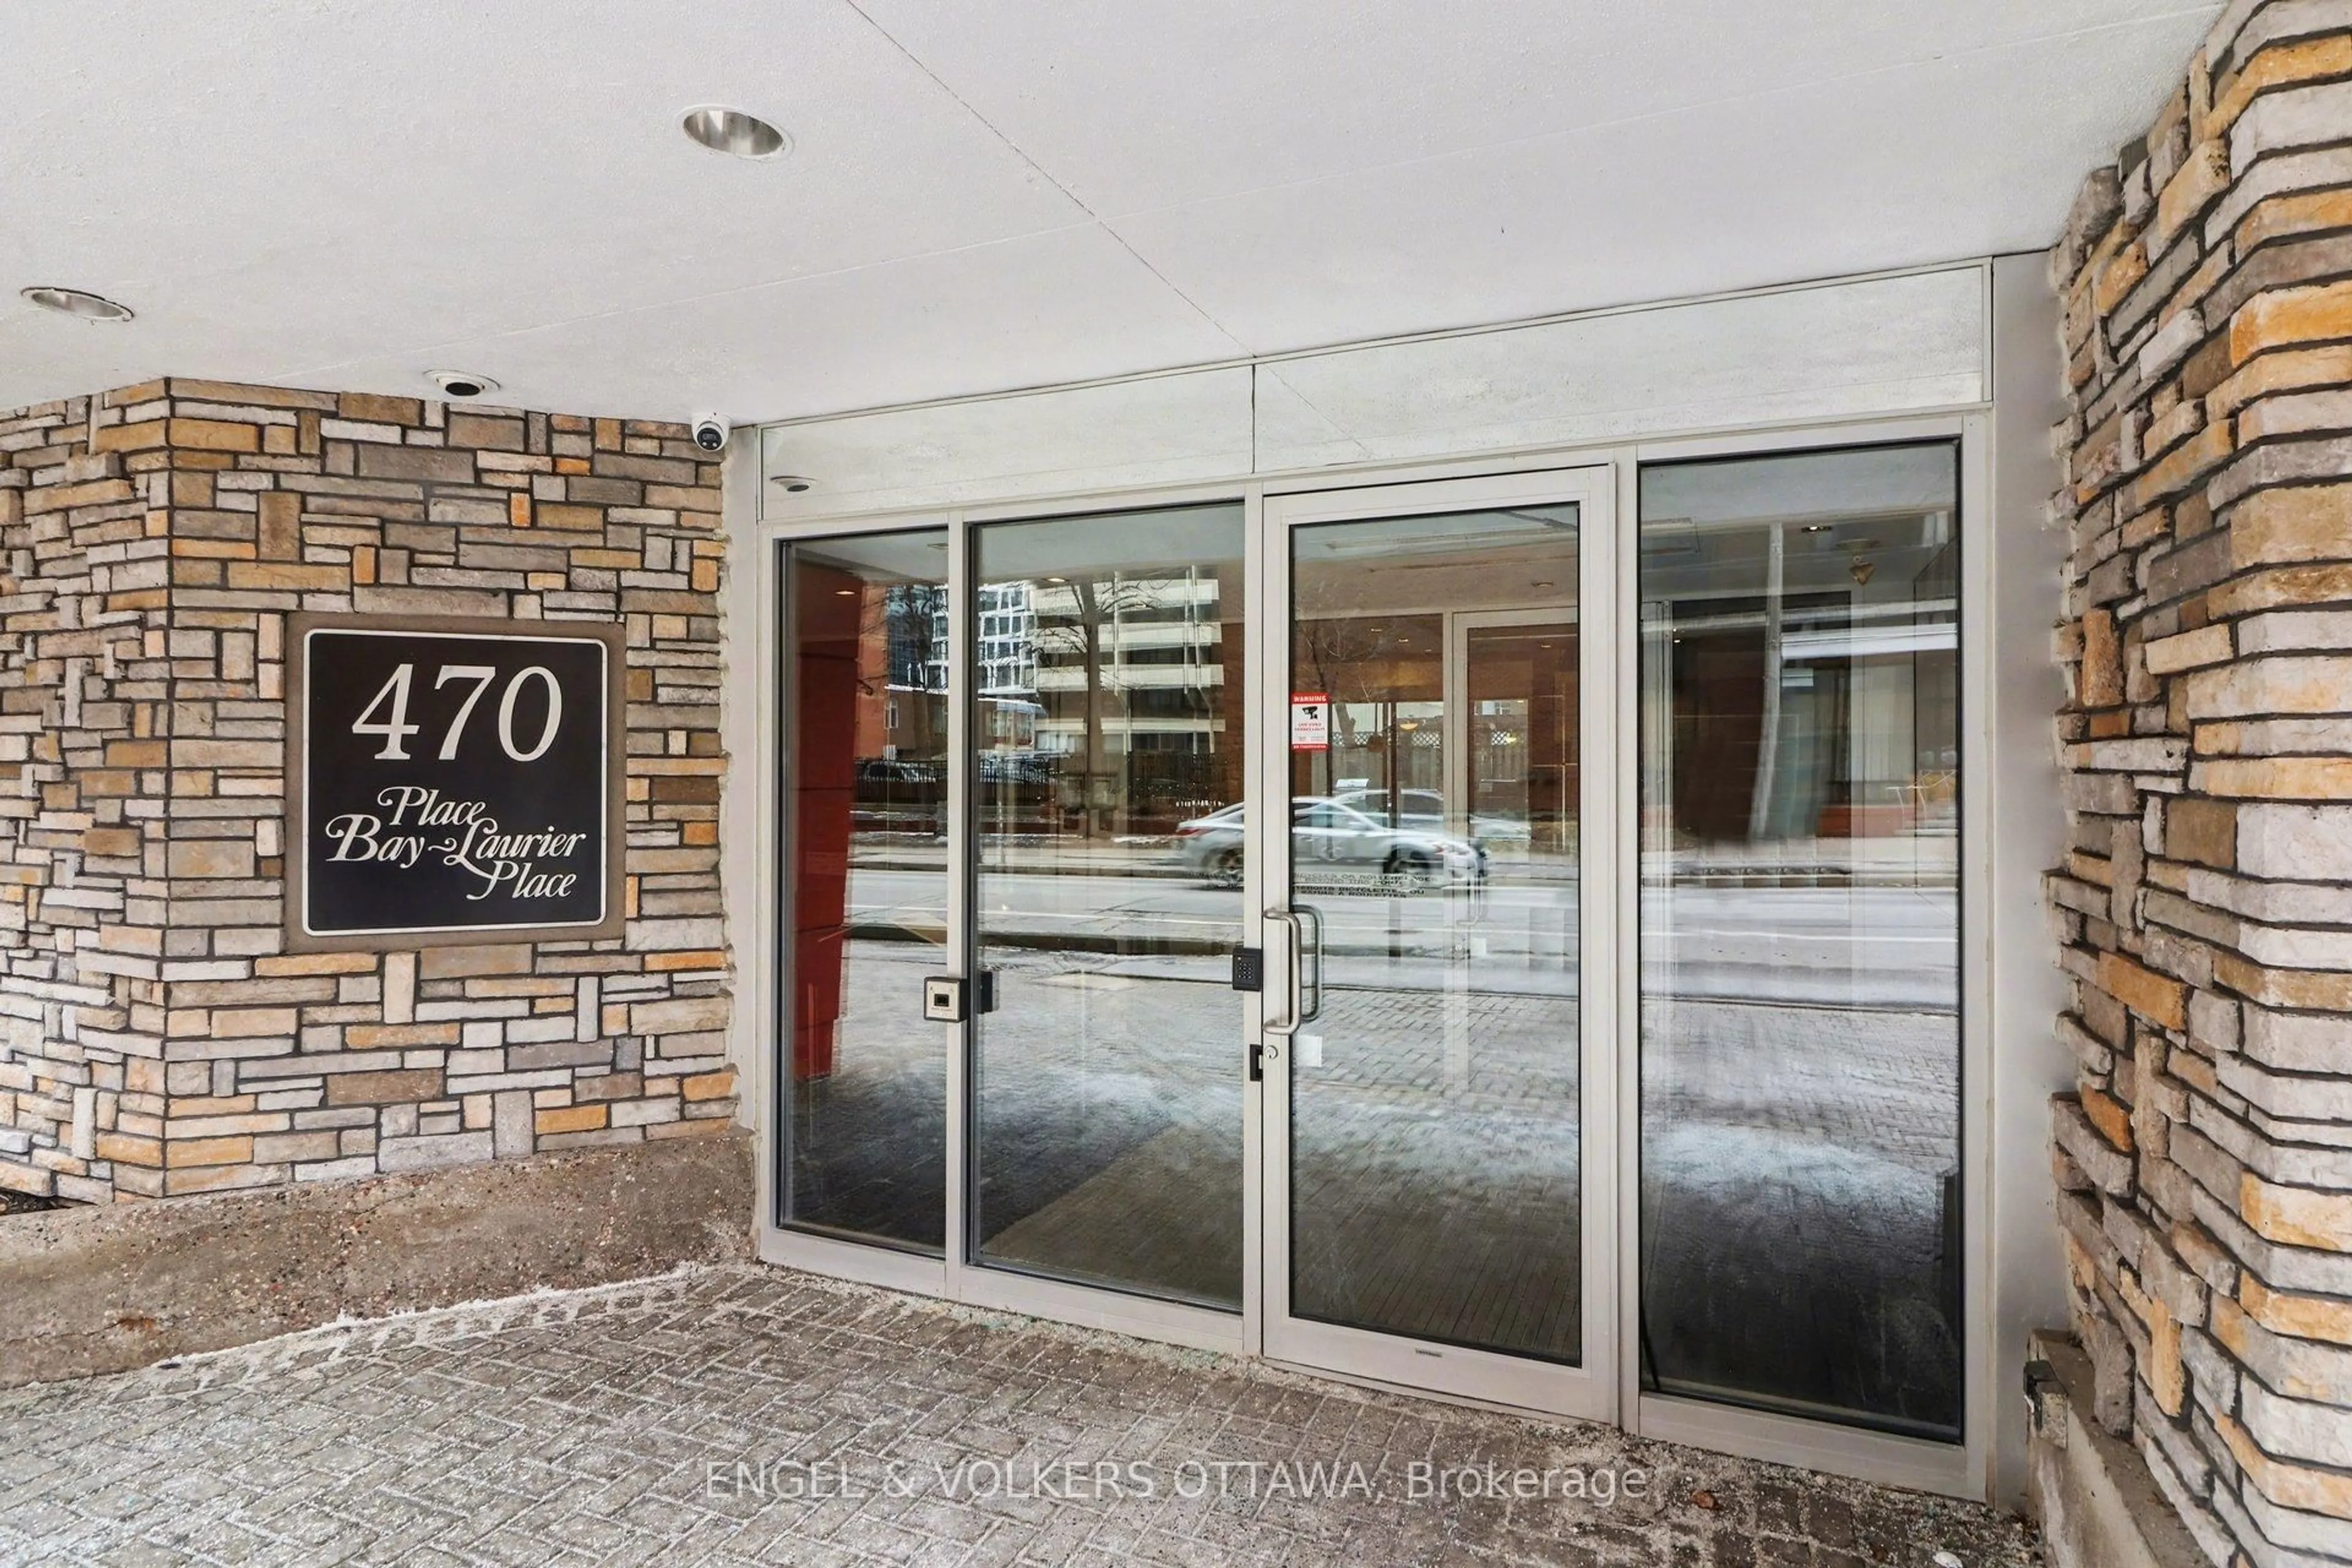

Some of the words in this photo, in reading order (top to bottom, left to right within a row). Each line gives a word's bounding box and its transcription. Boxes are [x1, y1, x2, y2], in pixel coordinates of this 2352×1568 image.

[352, 663, 562, 762] 470
[377, 786, 486, 826] Place
[466, 860, 577, 900] Place
